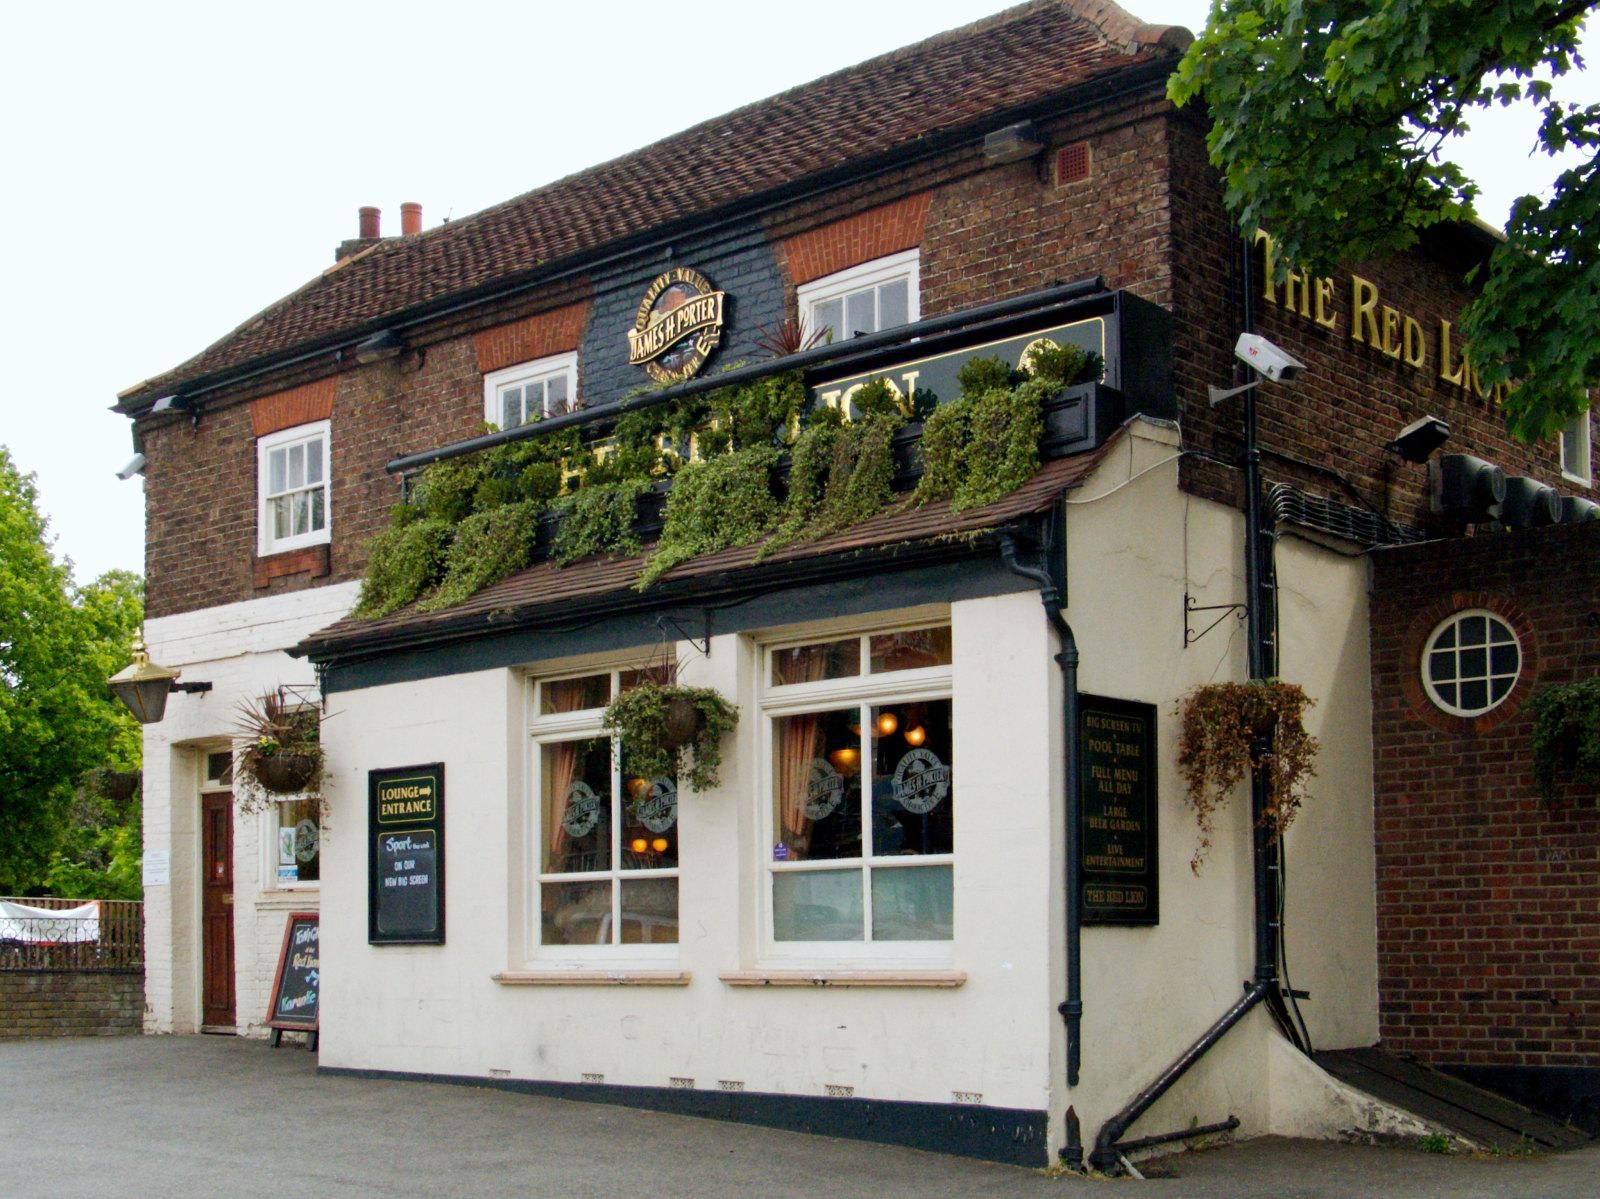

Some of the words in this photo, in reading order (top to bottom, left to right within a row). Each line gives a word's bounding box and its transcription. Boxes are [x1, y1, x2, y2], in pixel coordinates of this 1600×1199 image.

[1254, 227, 1338, 330] THE
[1351, 274, 1426, 368] RED
[1441, 318, 1513, 404] LI
[630, 324, 664, 361] JAMES
[677, 298, 715, 333] PORTER
[1088, 739, 1113, 753] POOL
[1116, 743, 1140, 757] TABLE
[1092, 766, 1112, 779] FULL
[1114, 768, 1138, 782] MENU
[381, 785, 420, 801] LOUNGE
[1098, 780, 1113, 793] ALL
[1116, 782, 1132, 795] DAY
[381, 800, 432, 816] ENTRANCE
[1103, 805, 1128, 818] LARGE
[1109, 818, 1141, 832] GARDEN
[385, 836, 412, 857] Sport
[1107, 844, 1124, 856] LIVE
[1086, 855, 1144, 868] ENTERTAINMENT
[409, 874, 429, 886] SCREEN
[1086, 889, 1105, 903] THE
[1125, 890, 1144, 904] LION
